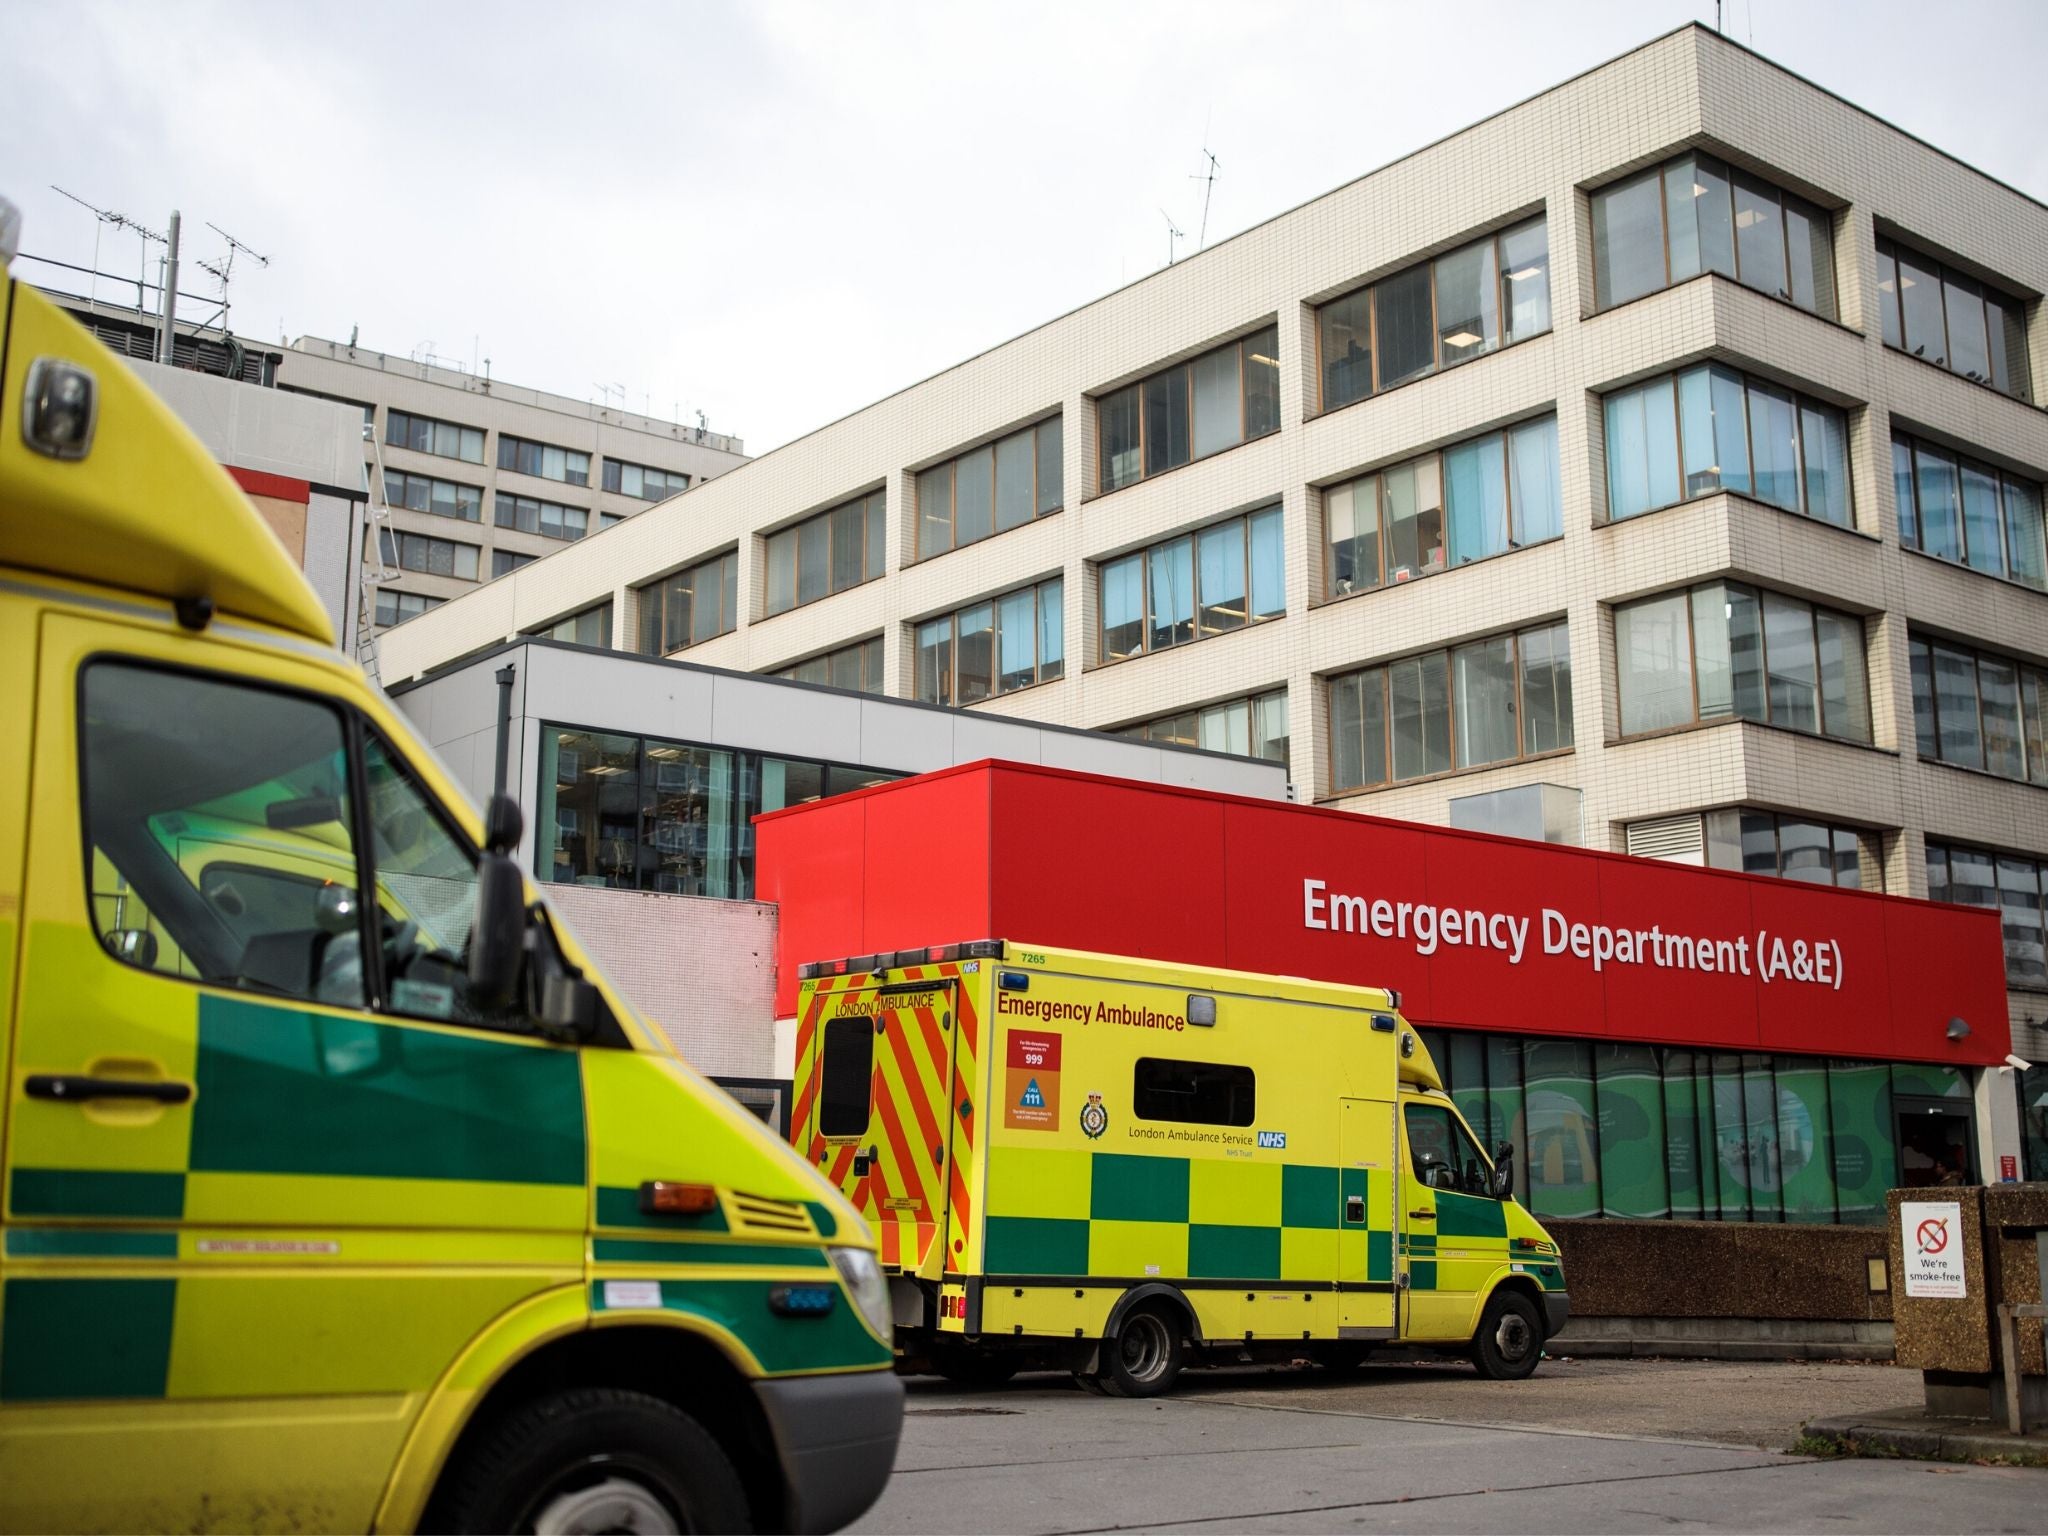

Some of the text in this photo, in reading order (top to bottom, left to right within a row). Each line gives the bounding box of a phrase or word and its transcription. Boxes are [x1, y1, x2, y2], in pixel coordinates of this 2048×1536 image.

[1303, 878, 1843, 990] Emergency Department (A&E)
[1021, 952, 1046, 964] 7265
[963, 962, 979, 973] NHS
[835, 1001, 874, 1017] LONDON
[997, 991, 1185, 1032] Emergency Ambulance
[1025, 1053, 1043, 1065] 999
[1025, 1094, 1040, 1105] 111
[1128, 1126, 1285, 1148] London Ambulance Service NHS
[1226, 1149, 1239, 1157] NHS
[1920, 1259, 1948, 1269] We're
[1909, 1271, 1961, 1282] smoke-free
